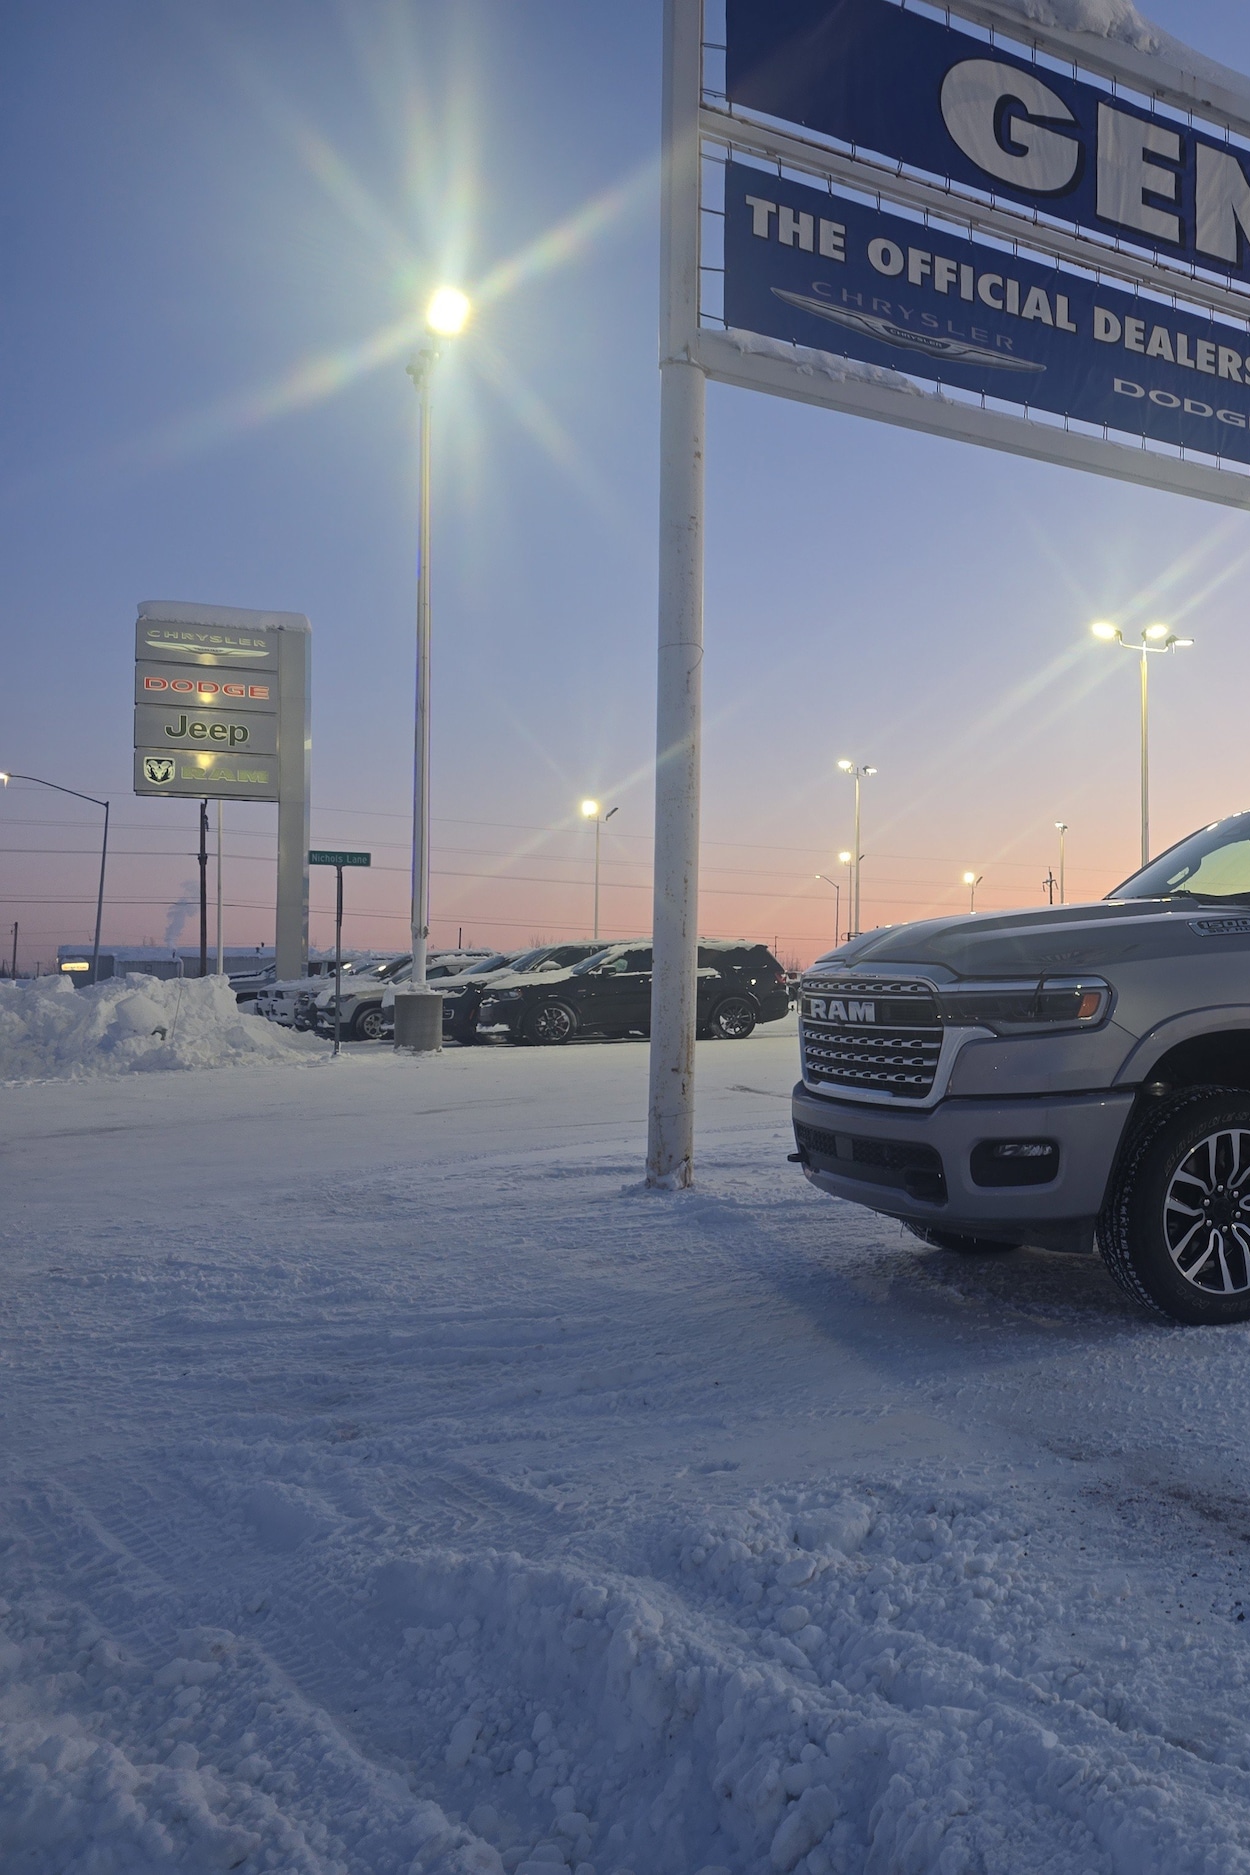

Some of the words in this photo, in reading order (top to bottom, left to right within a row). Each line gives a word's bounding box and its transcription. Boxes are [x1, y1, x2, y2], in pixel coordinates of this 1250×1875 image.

[744, 194, 847, 262] THE
[866, 237, 1078, 333] OFFICIAL
[811, 281, 1014, 351] CHRYSLER
[889, 328, 943, 348] CHRYSLER
[146, 629, 267, 648] CHRYSLER
[143, 676, 270, 699] DODGE
[164, 714, 250, 747] Jeep
[180, 765, 269, 784] RAM
[311, 853, 343, 863] Nichols
[346, 854, 368, 864] Lane
[810, 999, 875, 1022] RAM
